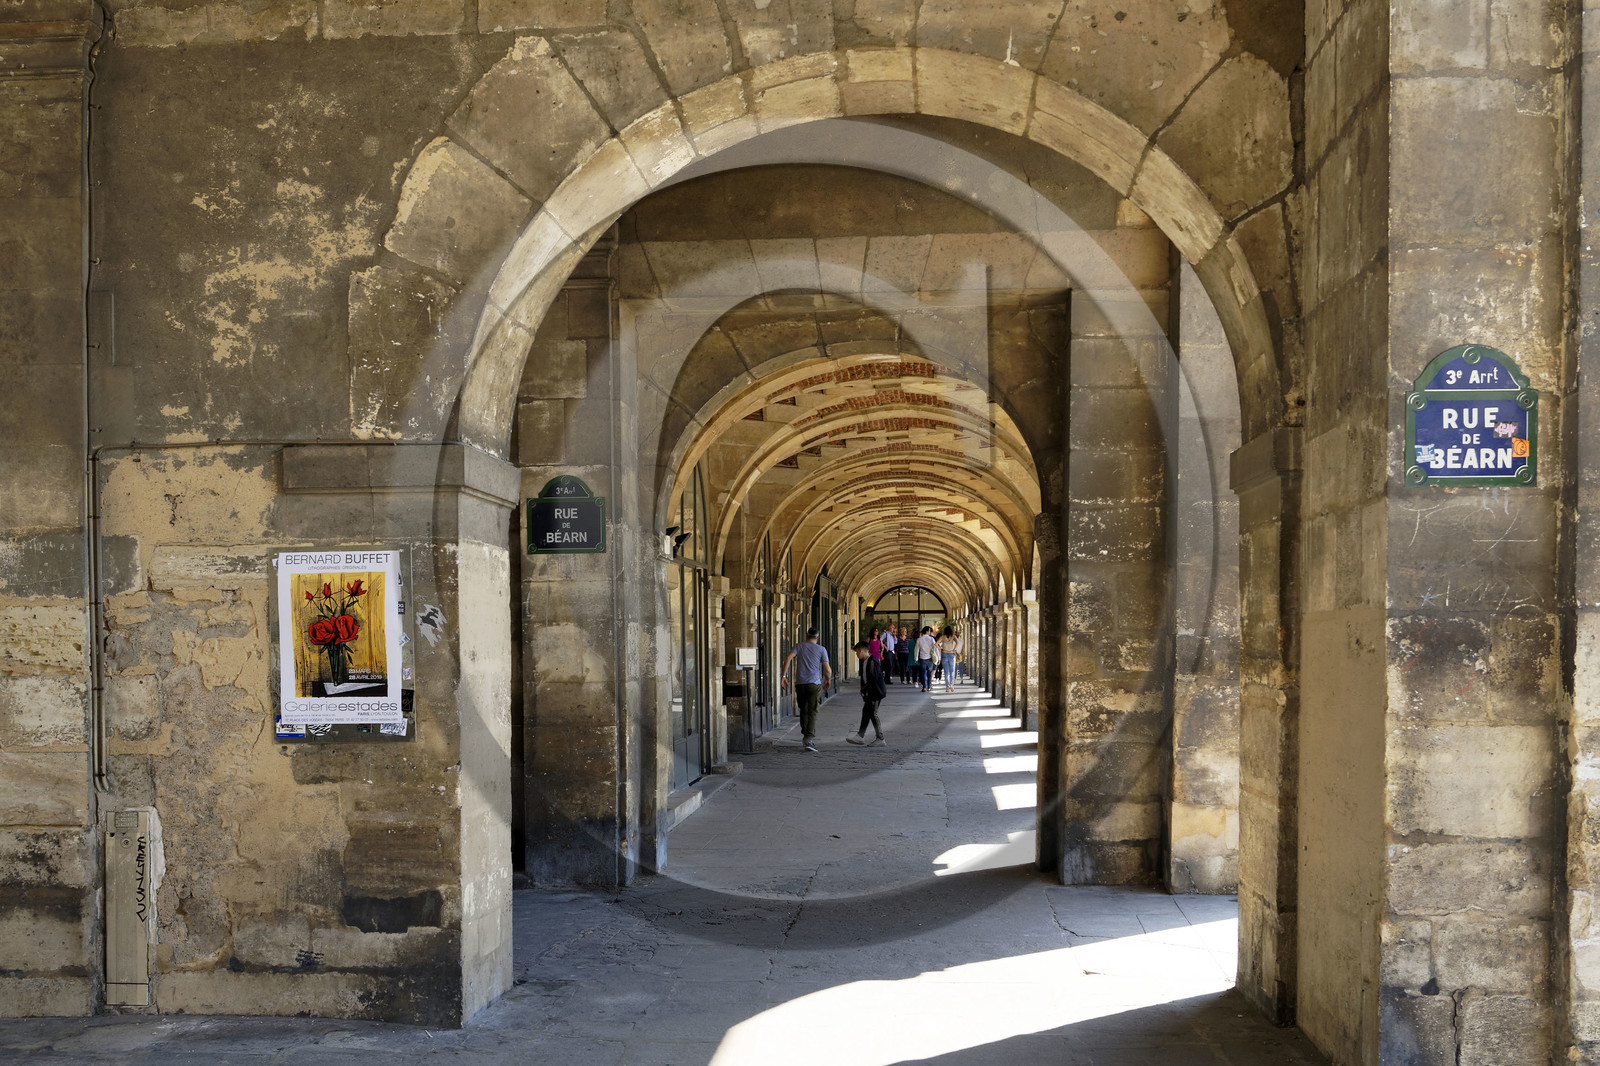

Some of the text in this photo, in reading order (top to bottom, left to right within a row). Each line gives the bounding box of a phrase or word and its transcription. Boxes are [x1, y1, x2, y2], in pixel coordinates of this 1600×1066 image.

[1446, 370, 1462, 385] 3e
[1442, 407, 1500, 429] RUE
[1462, 434, 1480, 444] DE
[1430, 445, 1512, 469] BÉARN
[555, 508, 578, 519] RUE
[546, 529, 587, 543] BÉARN
[285, 553, 390, 565] BERNARD BUFFET
